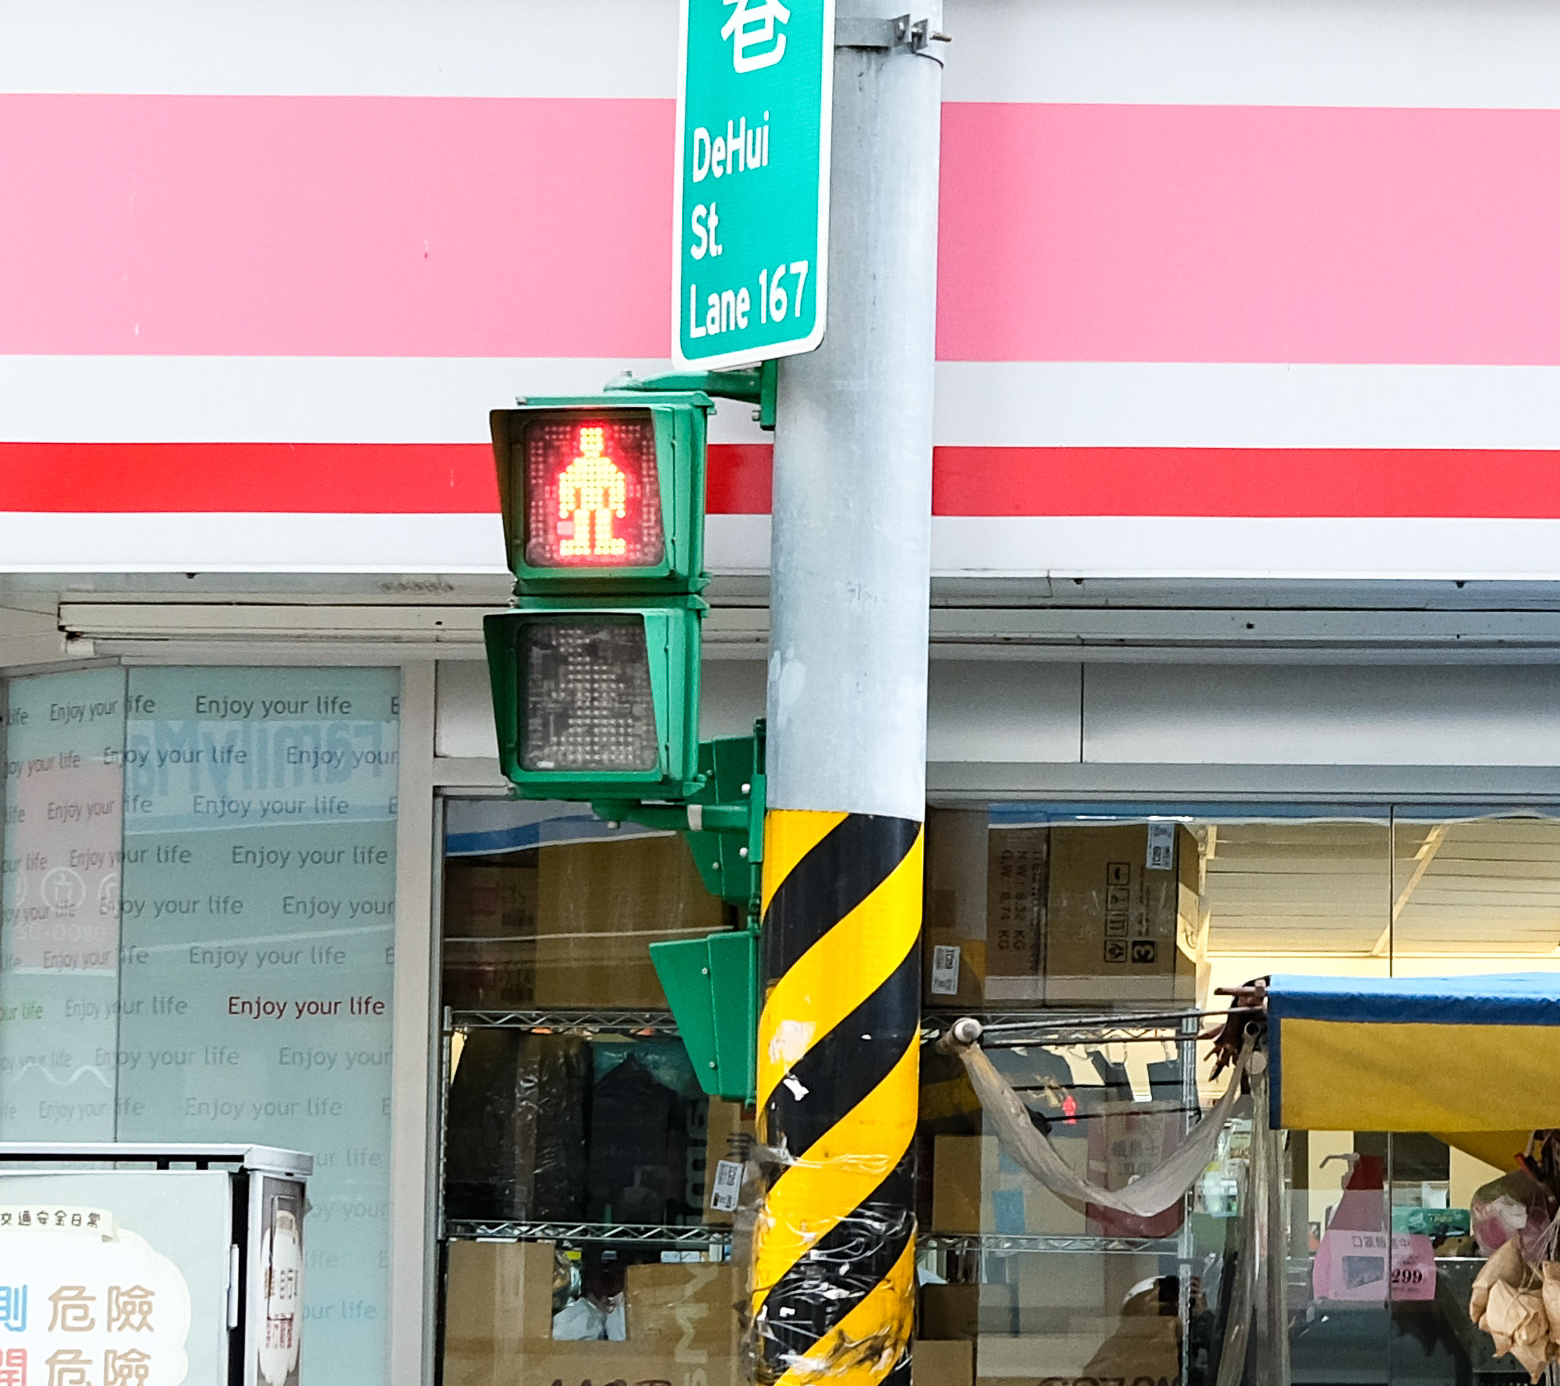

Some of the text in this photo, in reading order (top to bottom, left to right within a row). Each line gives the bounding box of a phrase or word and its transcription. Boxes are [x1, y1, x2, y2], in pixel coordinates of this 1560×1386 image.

[692, 111, 770, 184] DeHui
[691, 202, 723, 261] St.
[689, 260, 809, 341] Lane 167
[195, 695, 352, 719] Enjoy your life
[286, 745, 344, 768] Enjoy
[193, 795, 350, 819] Enjoy your life
[232, 845, 389, 869] Enjoy your life
[282, 896, 341, 918] Enjoy
[188, 945, 346, 969] Enjoy your life
[228, 995, 385, 1019] Enjoy your life
[47, 1283, 157, 1334] 危險
